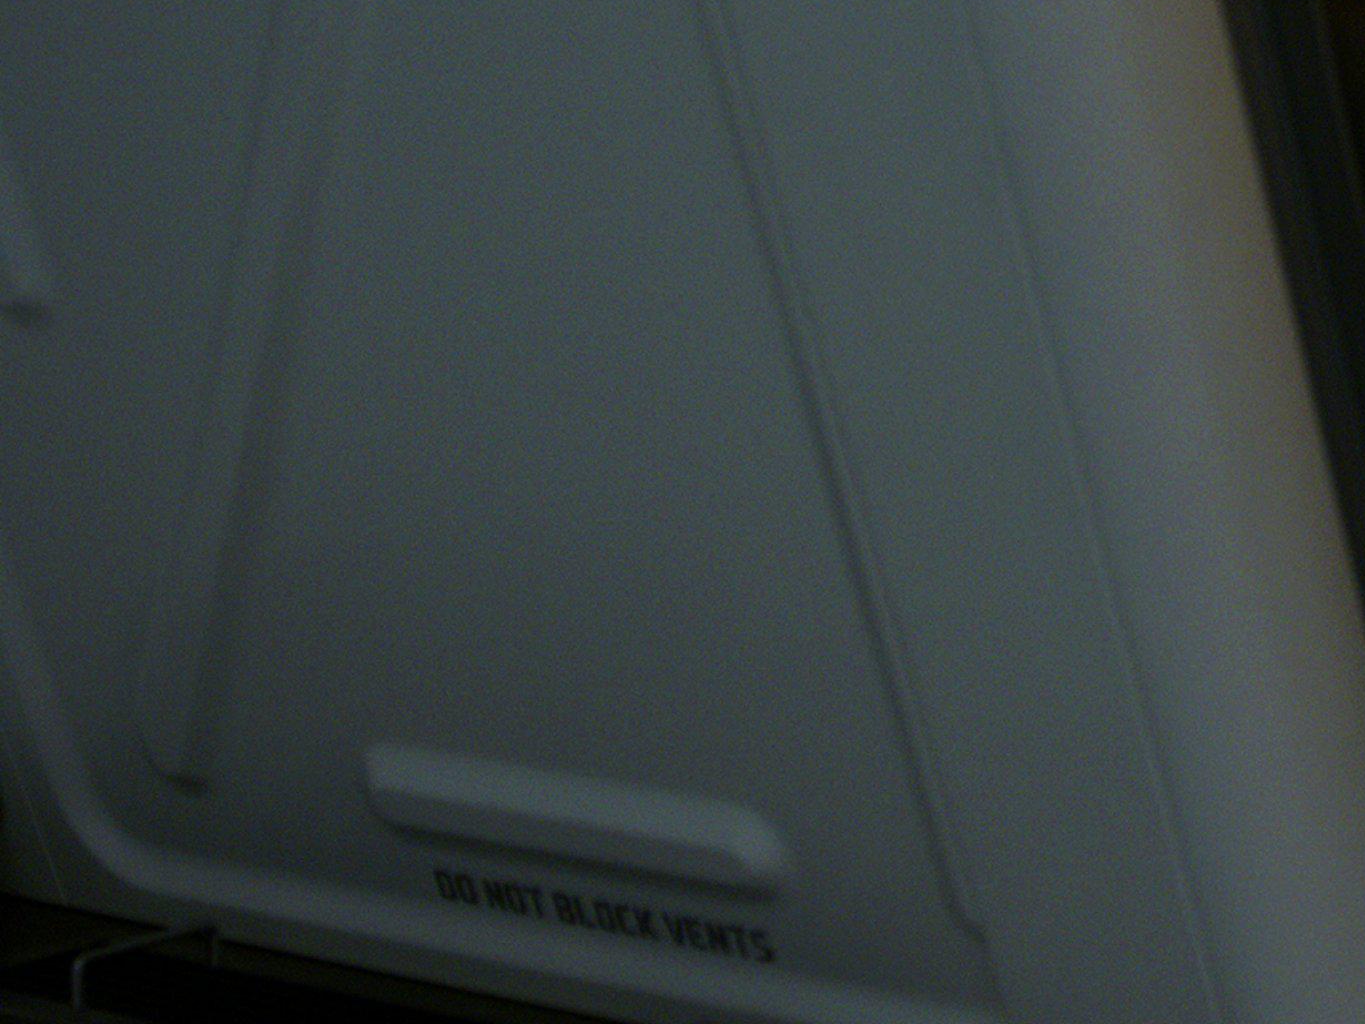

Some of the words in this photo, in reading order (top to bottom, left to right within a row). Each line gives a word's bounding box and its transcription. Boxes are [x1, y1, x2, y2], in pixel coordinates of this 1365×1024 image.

[434, 869, 479, 906] DO
[483, 879, 544, 918] NOT
[553, 891, 658, 939] BLOCK
[663, 911, 776, 963] VENTS
